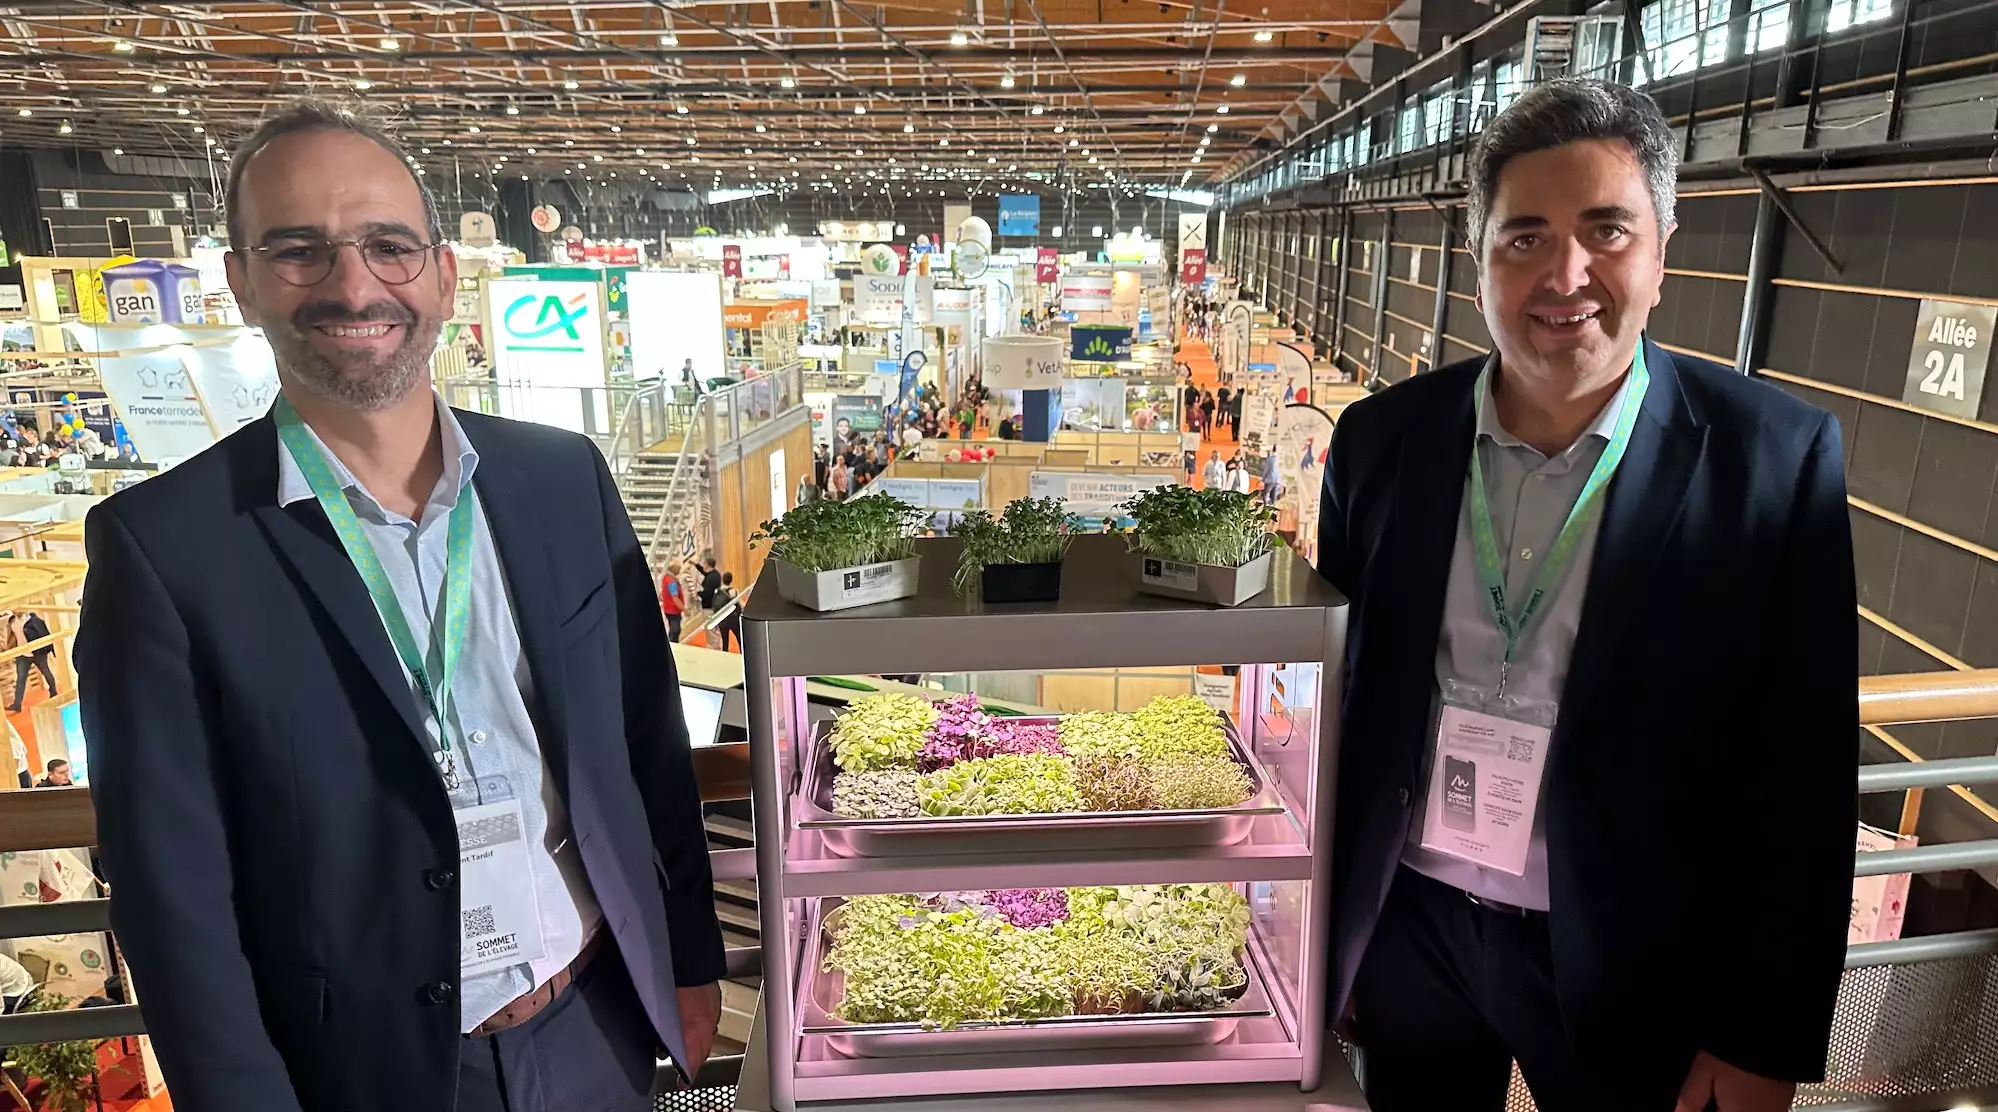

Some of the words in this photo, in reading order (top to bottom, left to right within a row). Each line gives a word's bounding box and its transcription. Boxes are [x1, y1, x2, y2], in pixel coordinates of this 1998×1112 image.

[115, 295, 155, 316] gan
[183, 293, 203, 313] ga
[1928, 316, 1977, 348] Allée
[1920, 350, 1964, 400] 2A
[1099, 484, 1133, 493] ACTEURS
[460, 835, 488, 849] ESSE
[471, 850, 493, 861] Tardif
[476, 933, 517, 951] SOMMET
